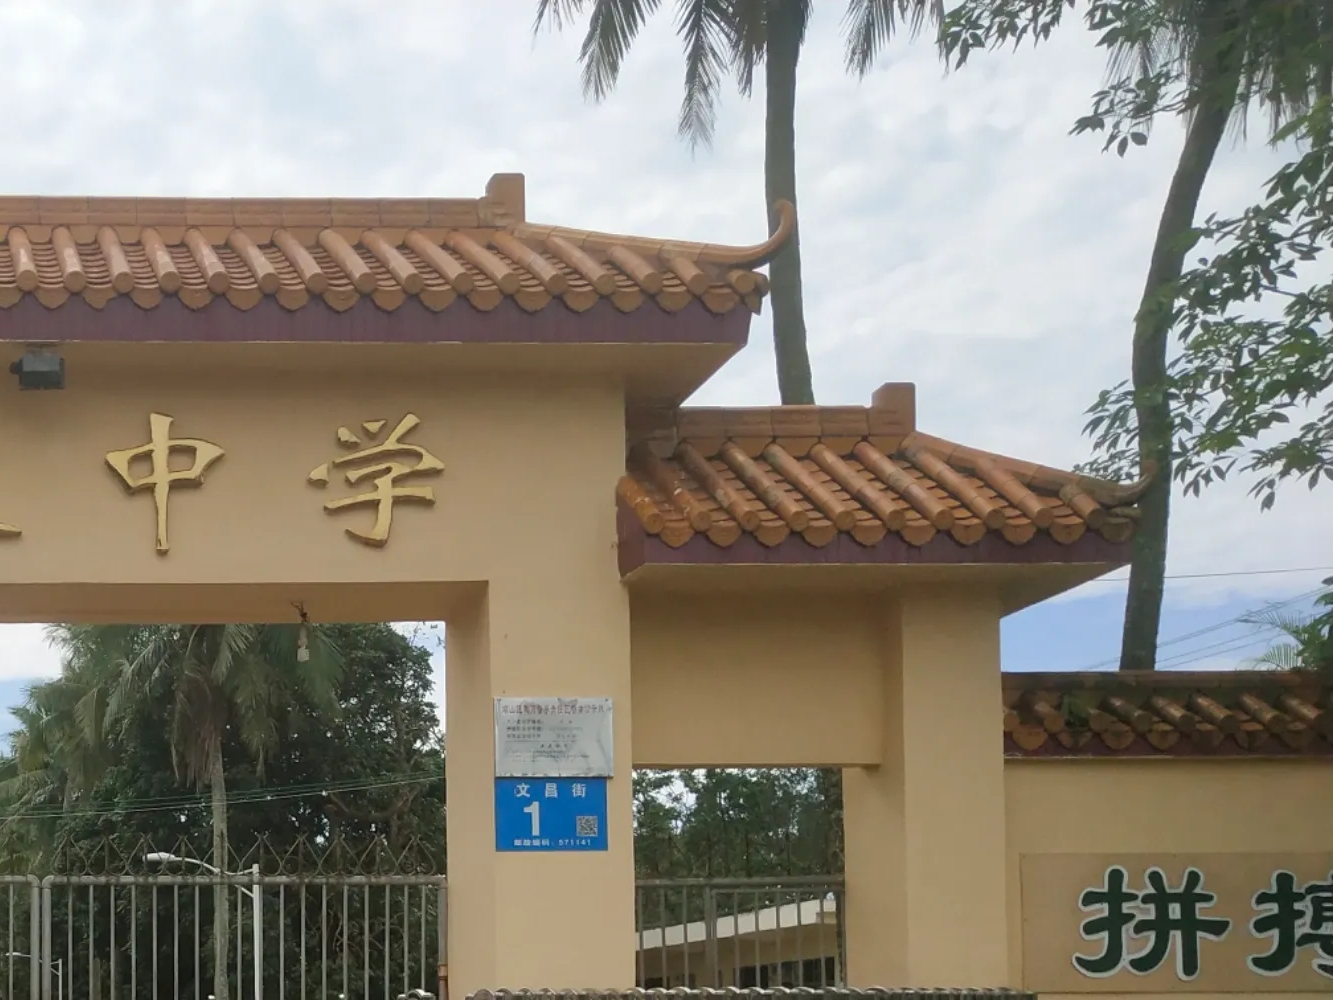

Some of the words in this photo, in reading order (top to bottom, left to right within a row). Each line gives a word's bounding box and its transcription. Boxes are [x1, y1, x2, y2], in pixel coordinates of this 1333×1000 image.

[514, 782, 586, 798] 文昌街
[523, 800, 540, 837] 1
